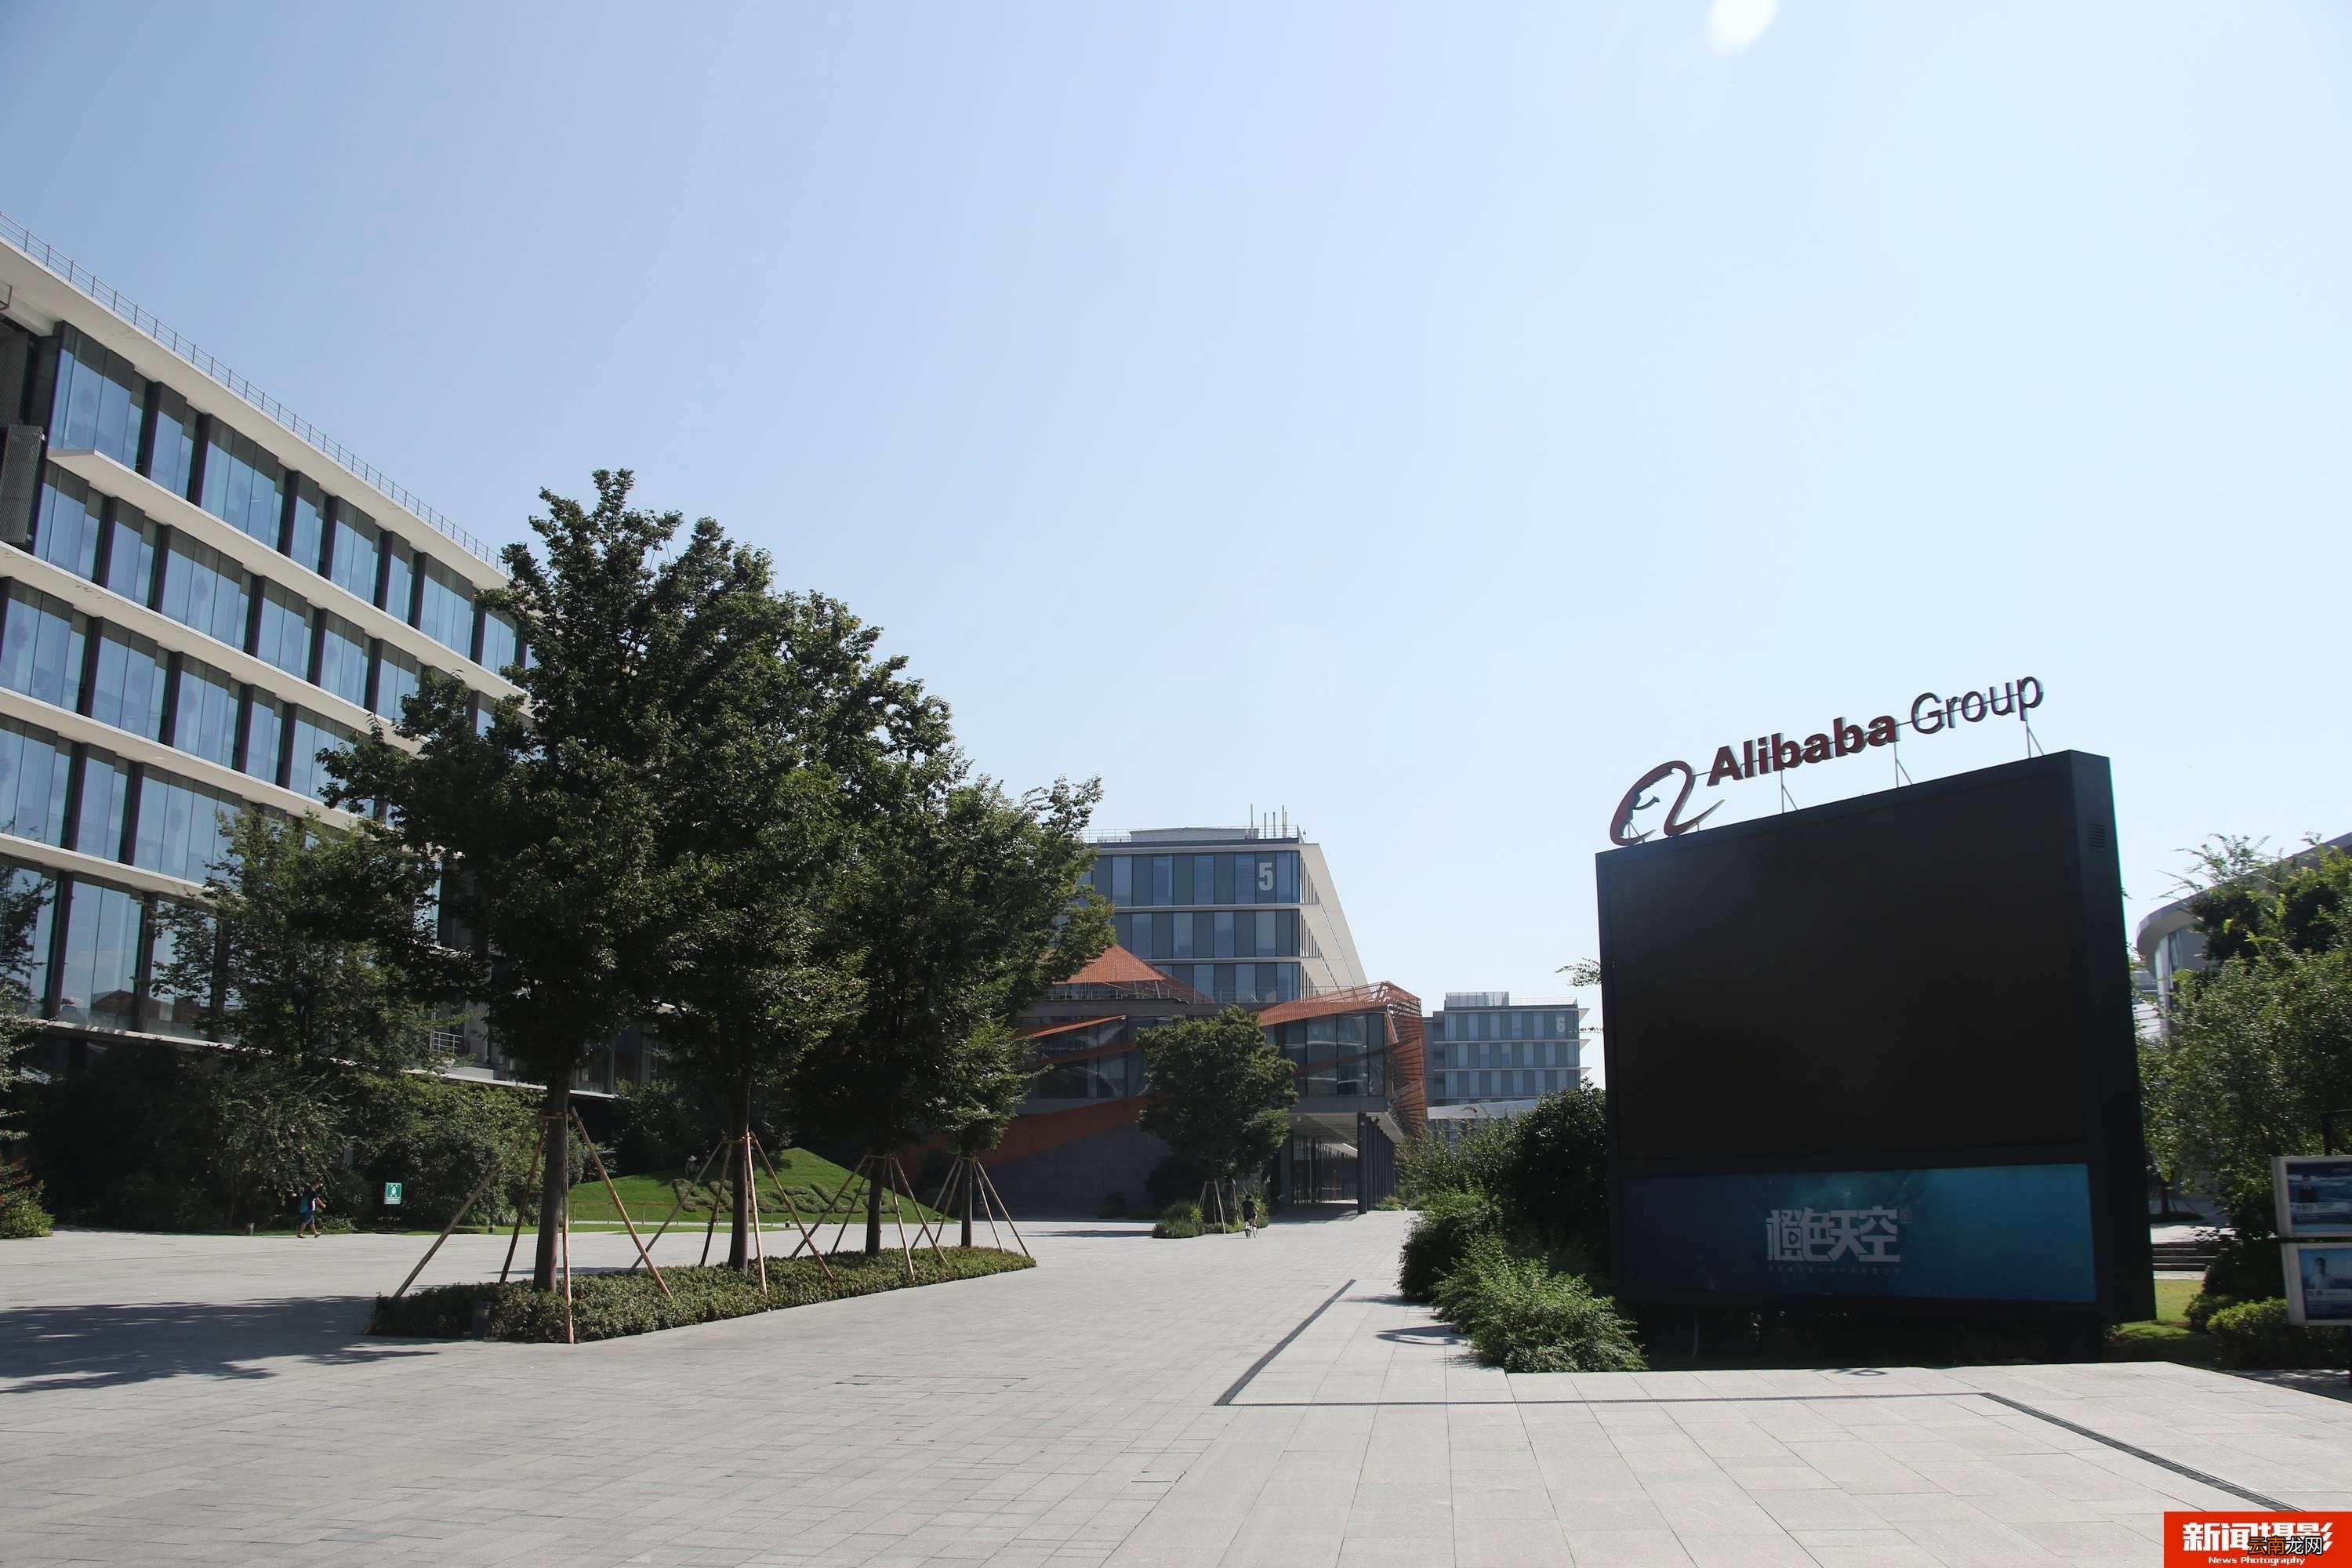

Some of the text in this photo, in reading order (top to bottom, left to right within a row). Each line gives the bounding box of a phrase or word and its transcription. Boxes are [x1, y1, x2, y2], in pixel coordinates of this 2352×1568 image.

[1707, 676, 2044, 786] Alibaba Group
[1258, 862, 1274, 891] 5
[1556, 1017, 1566, 1033] 6
[1766, 1205, 1900, 1261] 橙色天空
